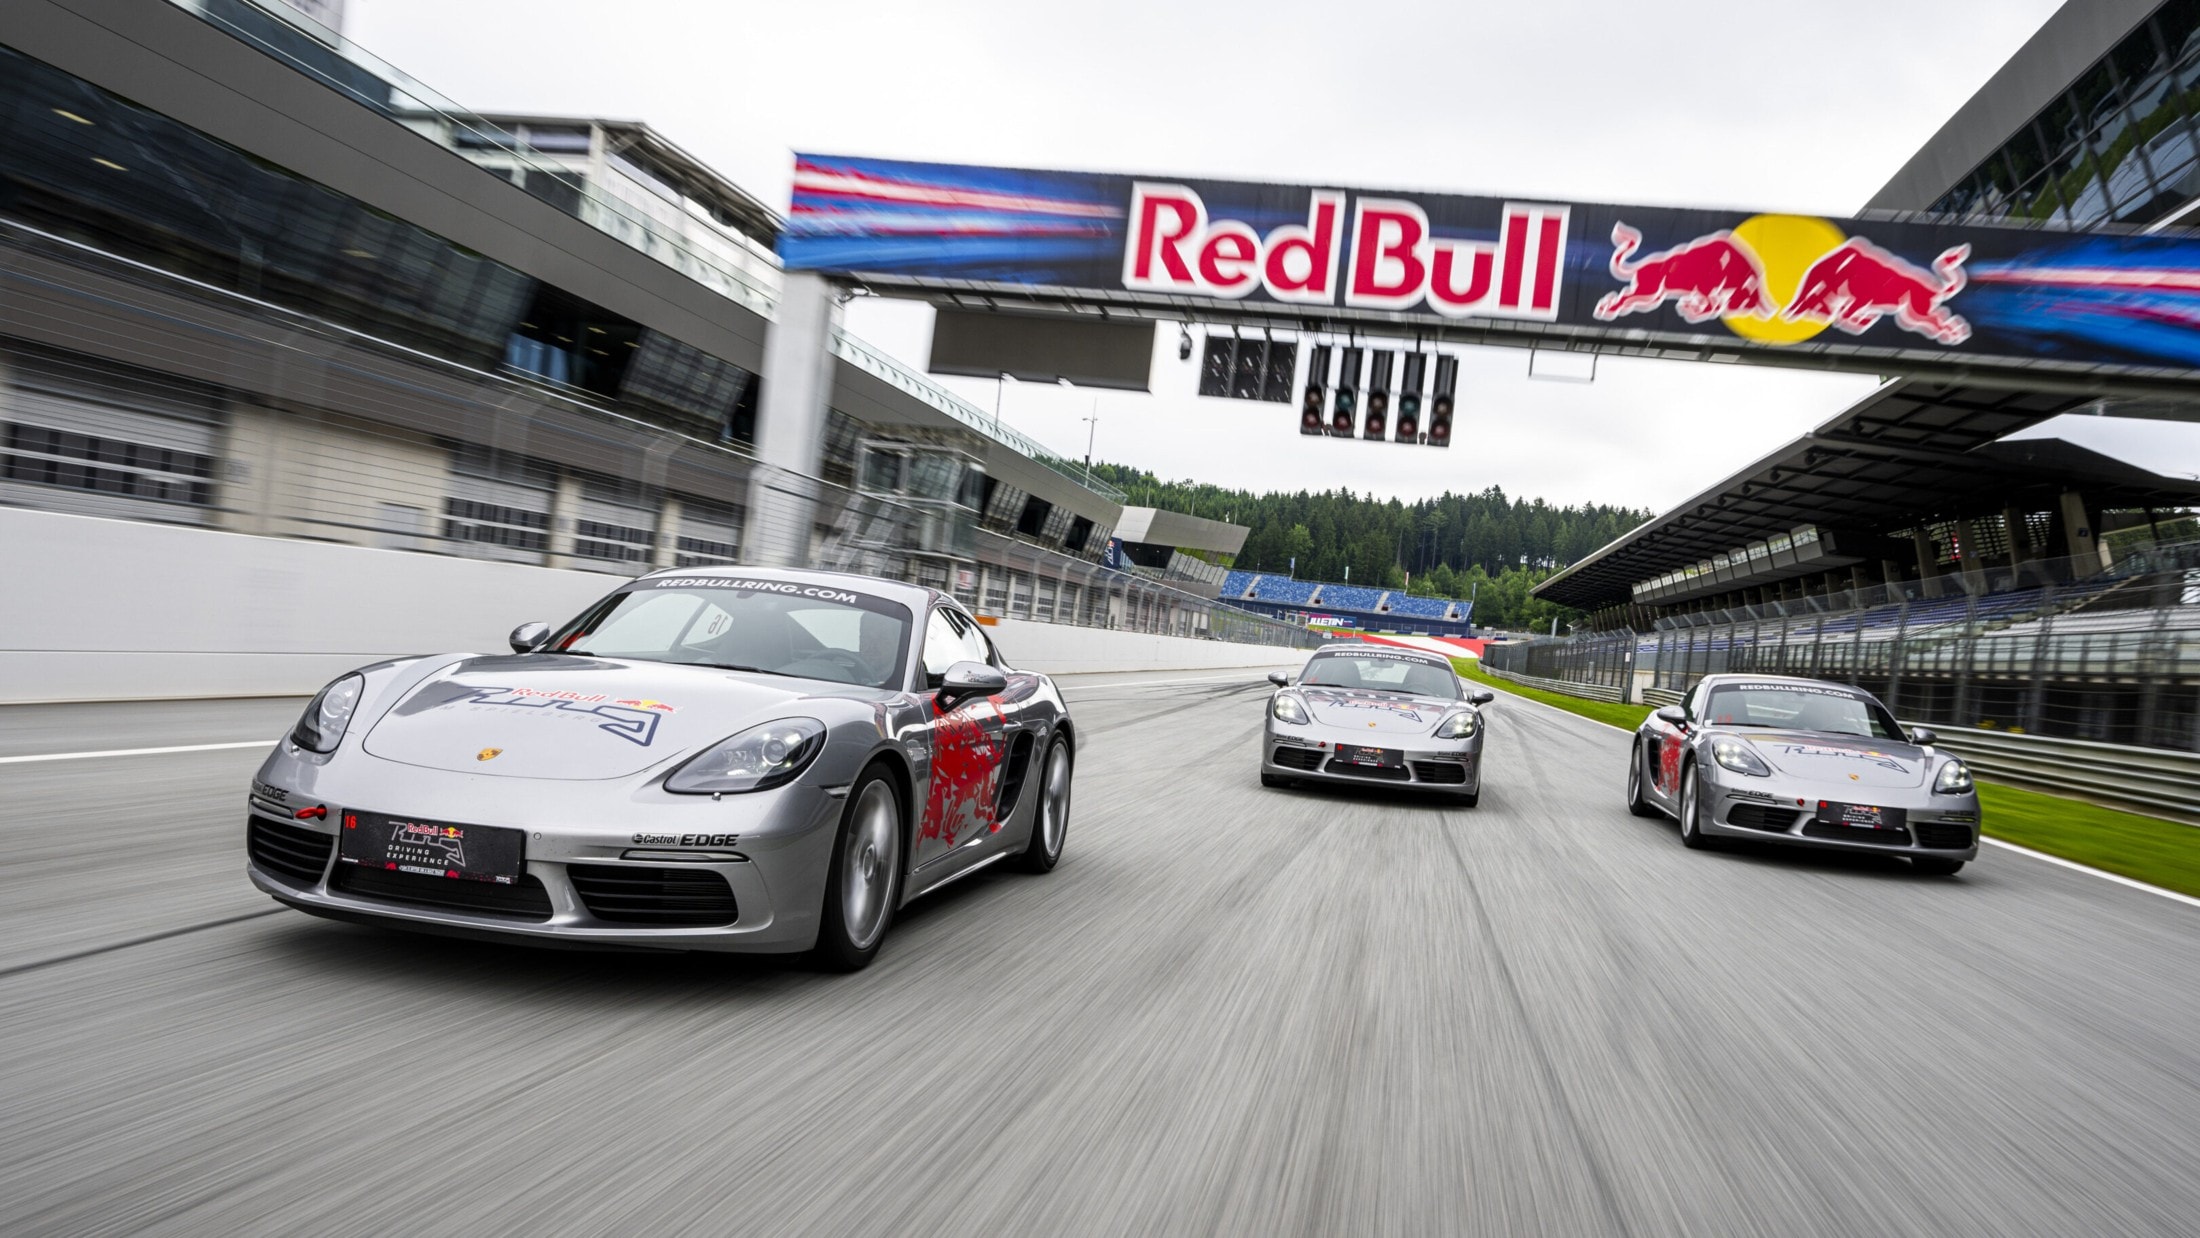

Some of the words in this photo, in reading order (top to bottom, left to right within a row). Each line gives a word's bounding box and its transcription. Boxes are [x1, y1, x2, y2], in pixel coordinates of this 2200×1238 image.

[657, 578, 858, 604] REDBULLRING.COM
[1334, 651, 1429, 665] REDBULLRING.COM
[1739, 684, 1856, 700] REDBULLRING.COM
[262, 784, 290, 802] EDGE
[345, 815, 357, 830] 16
[643, 833, 677, 845] Castrol
[680, 833, 740, 847] EDGE
[388, 844, 430, 856] DRIVING
[386, 852, 450, 867] EXPERIENCE
